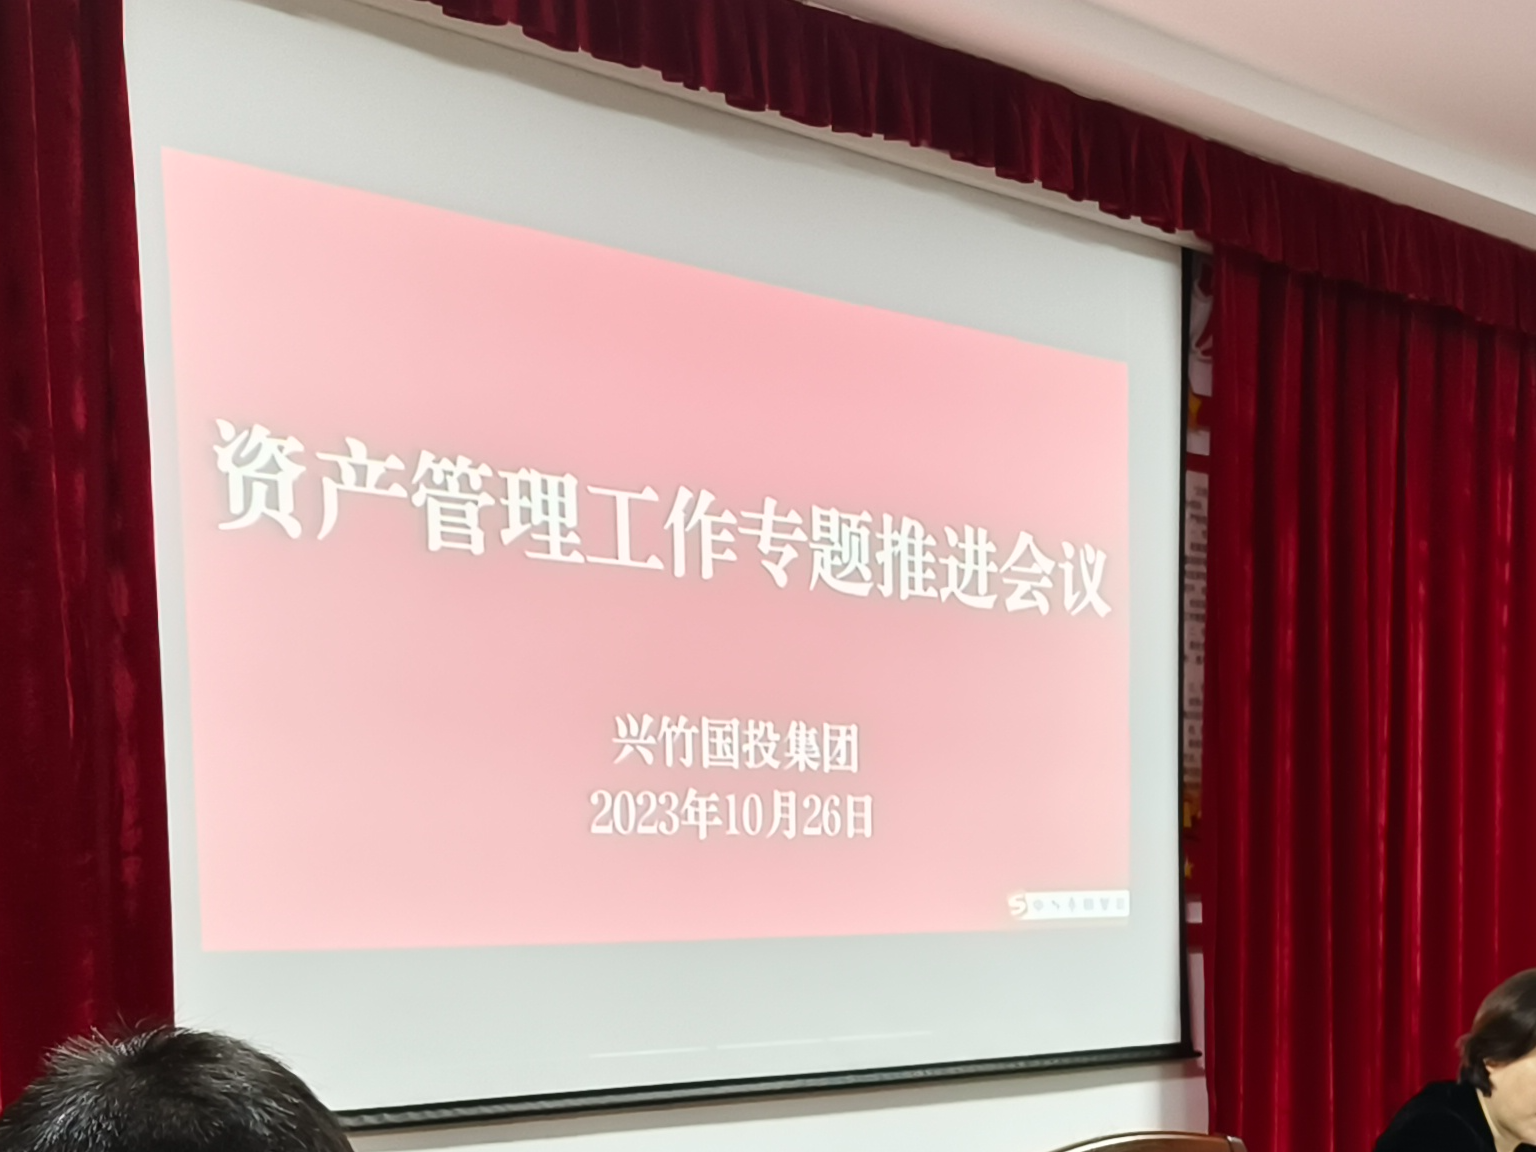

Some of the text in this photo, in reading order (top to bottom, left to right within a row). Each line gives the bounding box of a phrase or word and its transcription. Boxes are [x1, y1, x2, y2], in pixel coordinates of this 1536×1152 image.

[213, 418, 1112, 618] 资产管理工作专题推进会议
[611, 713, 859, 774] 兴竹国投集团
[590, 787, 873, 840] 2023年10月26日
